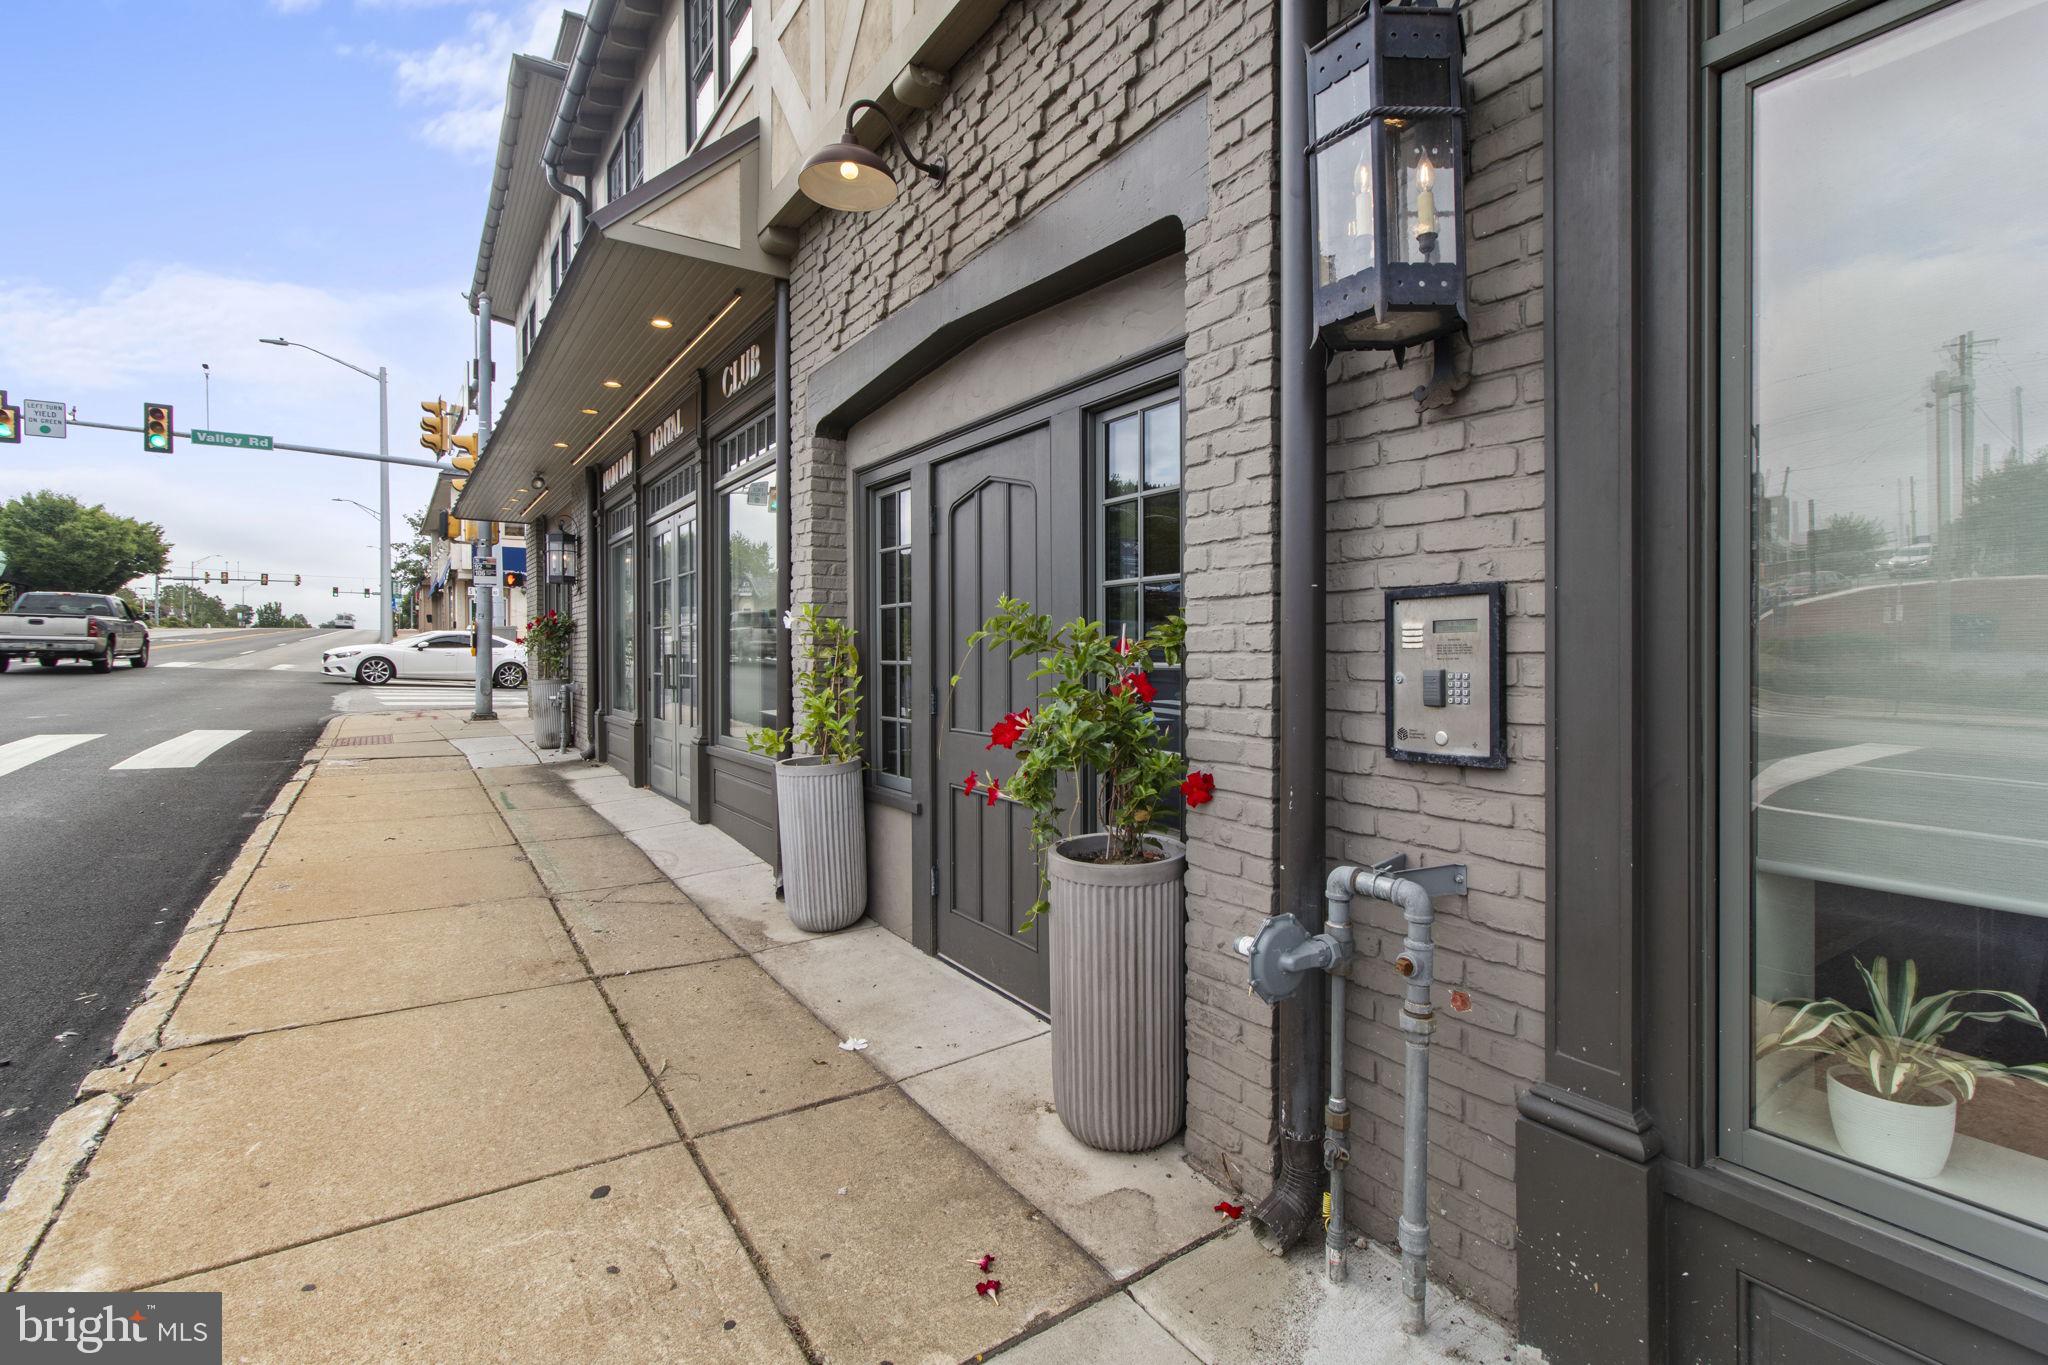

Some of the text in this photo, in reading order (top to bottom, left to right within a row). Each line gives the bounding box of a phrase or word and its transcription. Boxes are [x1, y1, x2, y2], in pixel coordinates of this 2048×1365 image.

[722, 344, 761, 398] CLUB
[34, 410, 57, 418] YIELD
[196, 432, 269, 447] Valley Rd
